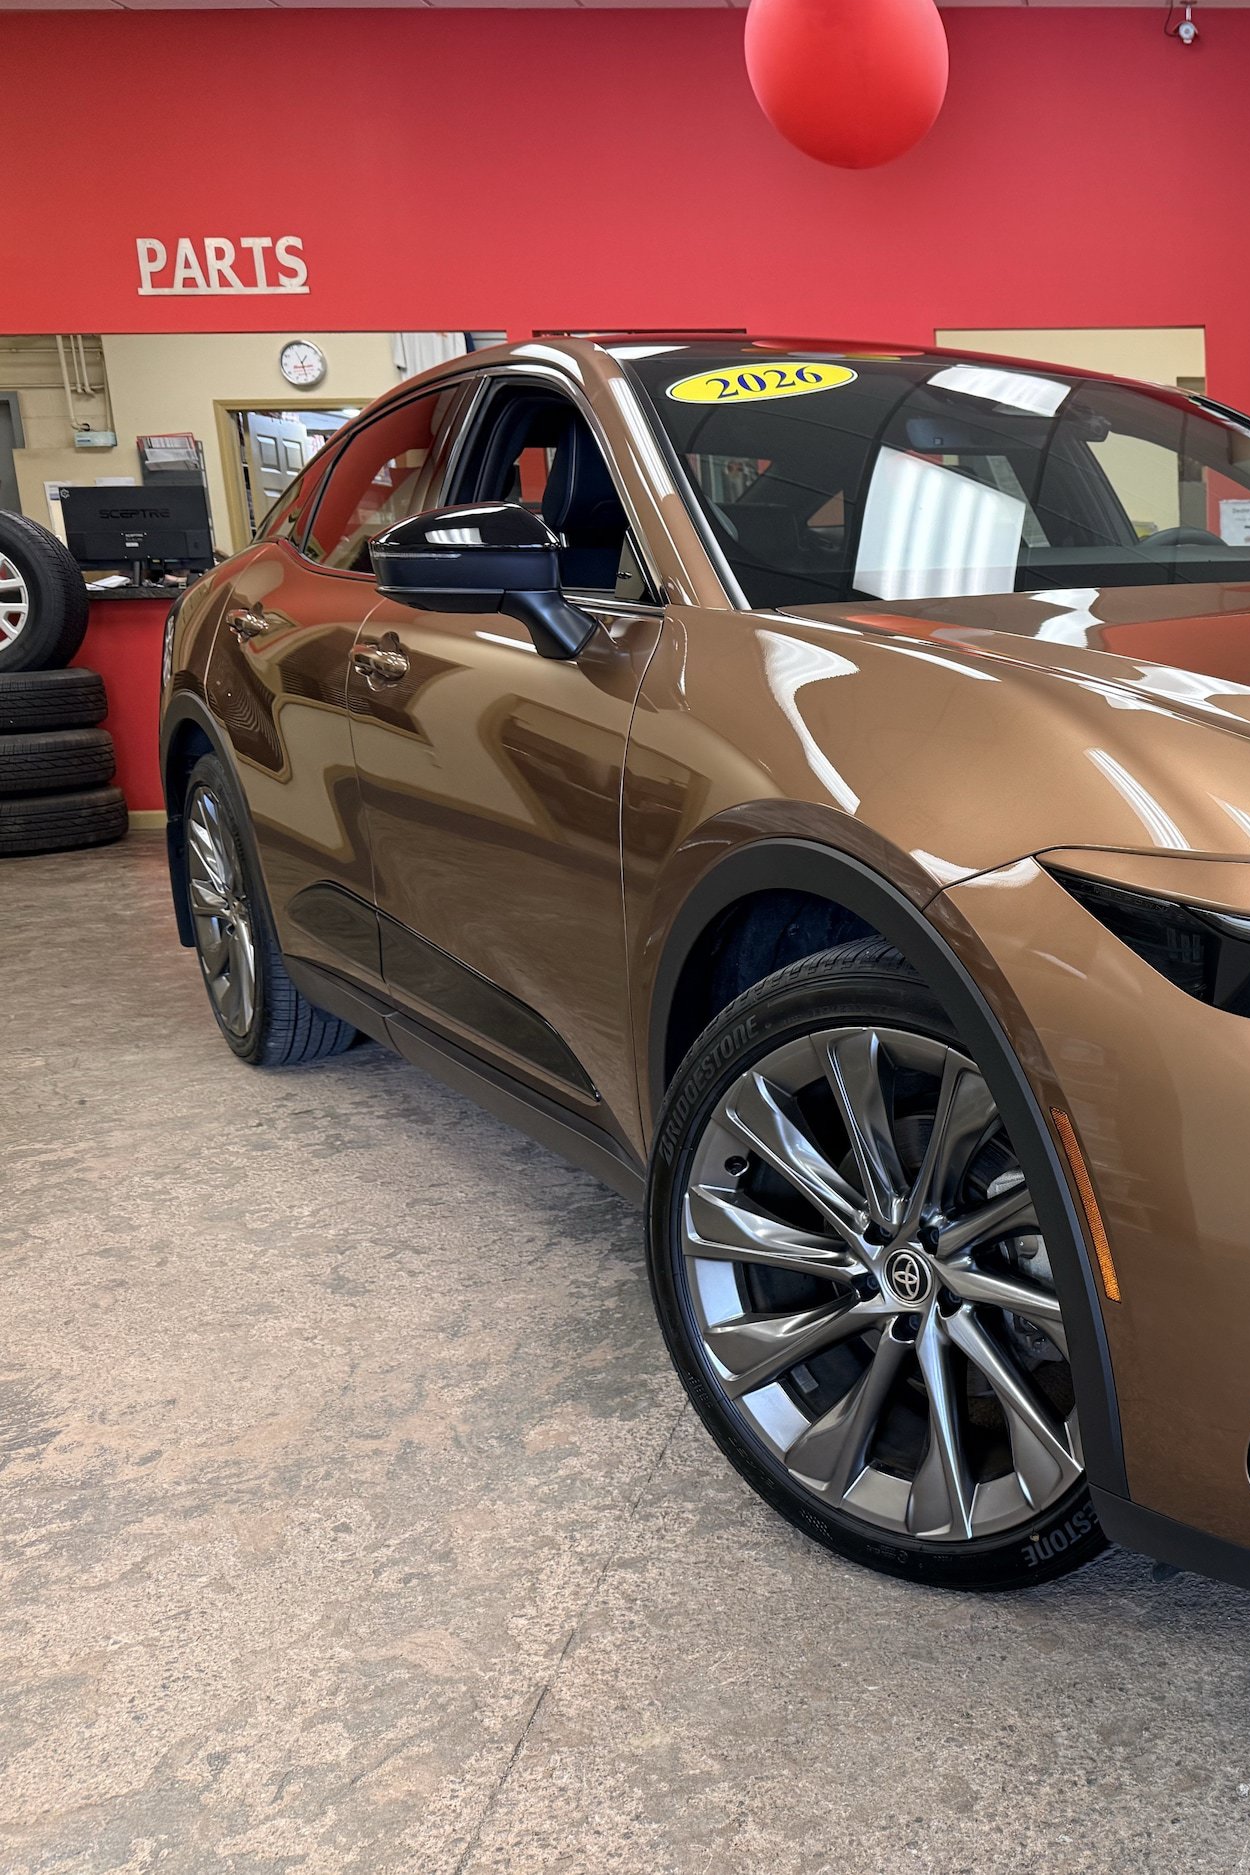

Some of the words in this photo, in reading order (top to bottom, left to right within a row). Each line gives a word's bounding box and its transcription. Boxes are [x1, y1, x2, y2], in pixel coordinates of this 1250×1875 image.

[136, 236, 308, 290] PARTS
[706, 366, 823, 399] 2026
[99, 508, 170, 519] SCEPTRE
[658, 1014, 759, 1167] BRIDGESTONE
